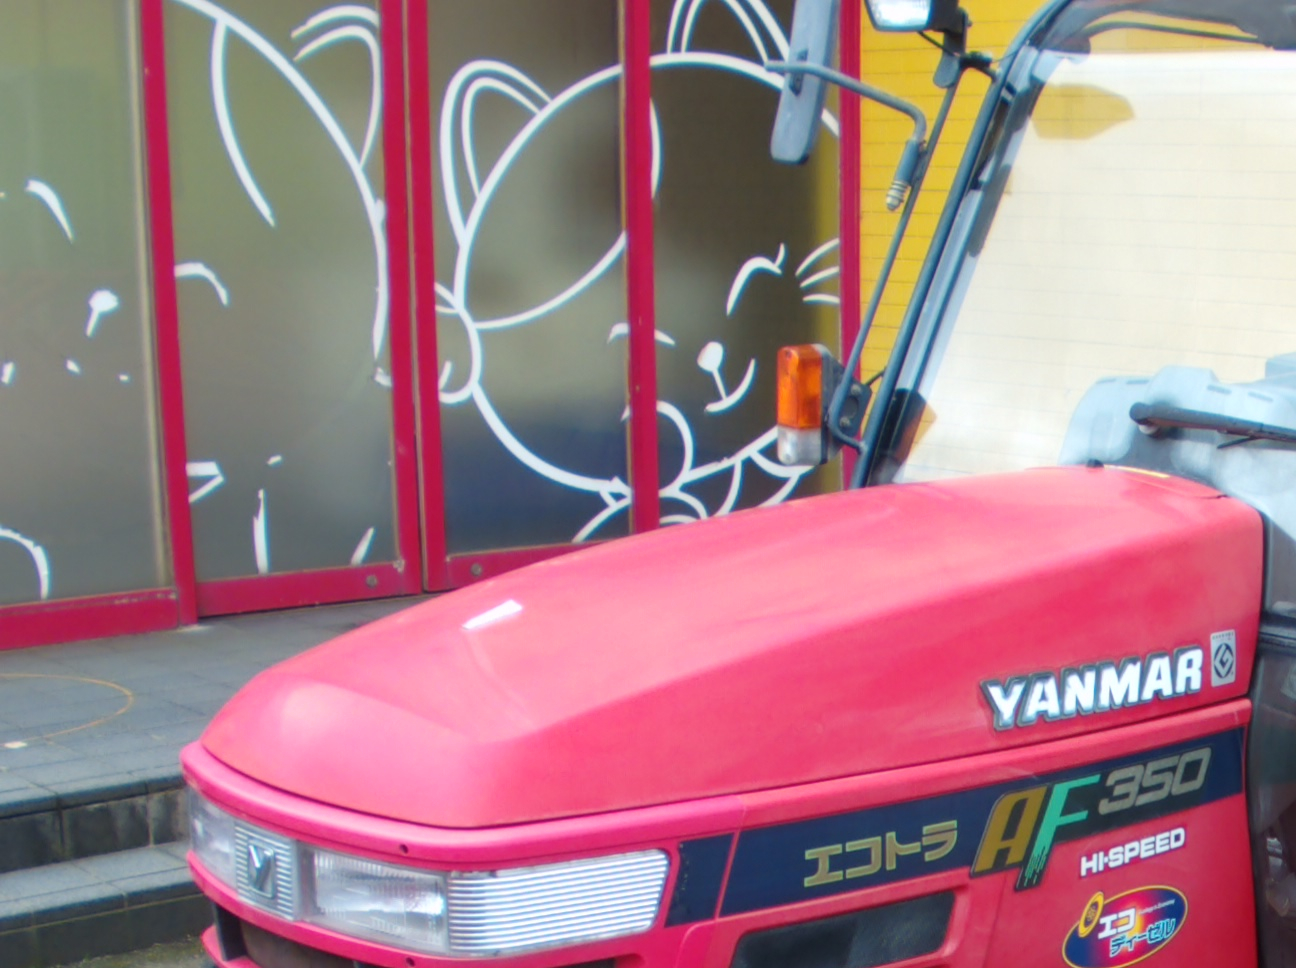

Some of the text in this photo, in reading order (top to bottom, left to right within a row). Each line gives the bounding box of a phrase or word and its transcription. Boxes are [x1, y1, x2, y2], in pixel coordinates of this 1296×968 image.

[983, 646, 1204, 730] YANMAR
[804, 819, 958, 888] エコトラ
[1098, 907, 1136, 939] エコ
